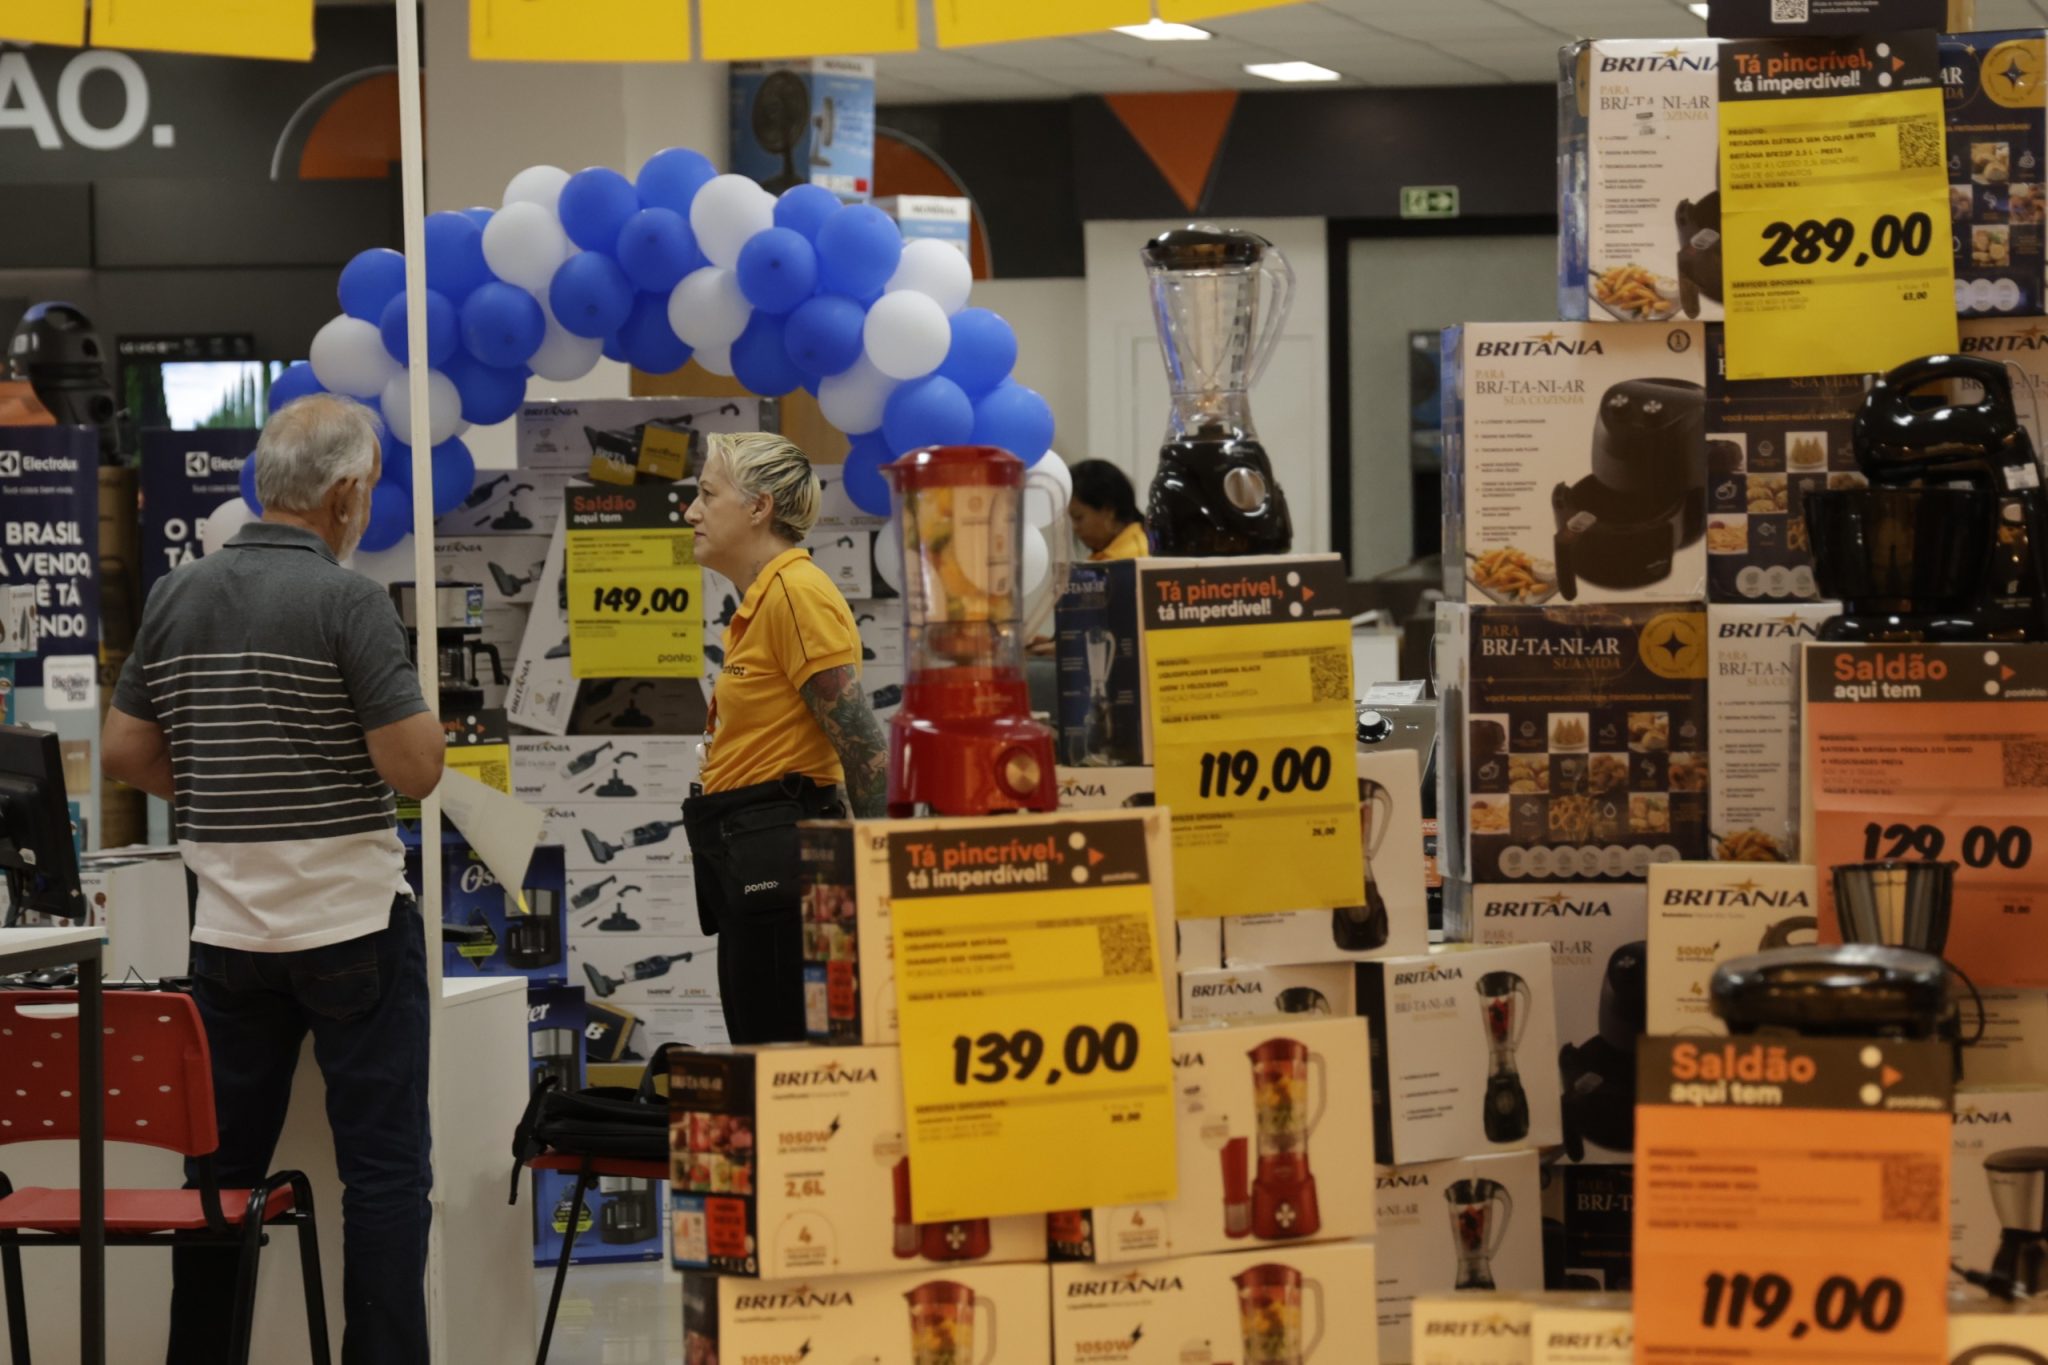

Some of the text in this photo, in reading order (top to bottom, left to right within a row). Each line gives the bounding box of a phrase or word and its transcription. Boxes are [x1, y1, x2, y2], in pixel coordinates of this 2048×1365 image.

[1599, 56, 1720, 73] BRITANI
[1734, 48, 1873, 77] Tá pincrível,
[1734, 69, 1861, 94] tá imperdível!
[1759, 211, 1932, 268] 289,00
[1476, 379, 1585, 395] BRI-TA-NI-AR
[23, 456, 78, 471] Electrolux
[574, 495, 637, 512] Saldão
[164, 518, 188, 541] O
[574, 512, 622, 525] aqui tem
[5, 521, 84, 546] BRASIL
[14, 552, 92, 579] VENDO,
[55, 577, 82, 607] TÁ
[594, 587, 689, 616] 149,00
[1157, 575, 1284, 606] Tá pincrível,
[1158, 598, 1272, 623] tá imperdível!
[1481, 637, 1621, 656] BRI-TA-NI-AR
[1834, 652, 1948, 681] Saldão
[1834, 681, 1921, 701] aqui tem
[1199, 746, 1331, 801] 119,00
[906, 837, 1064, 870] Tá pincrível,
[1864, 823, 2033, 869] 12900
[907, 862, 1049, 891] tá imperdível!
[953, 1021, 1140, 1086] 139,00
[1671, 1043, 1816, 1083] Saldão
[1670, 1080, 1782, 1106] aqui tem
[1952, 1111, 2012, 1126] TANIA
[1376, 1174, 1429, 1190] TANIA
[1702, 1271, 1904, 1340] 119,00
